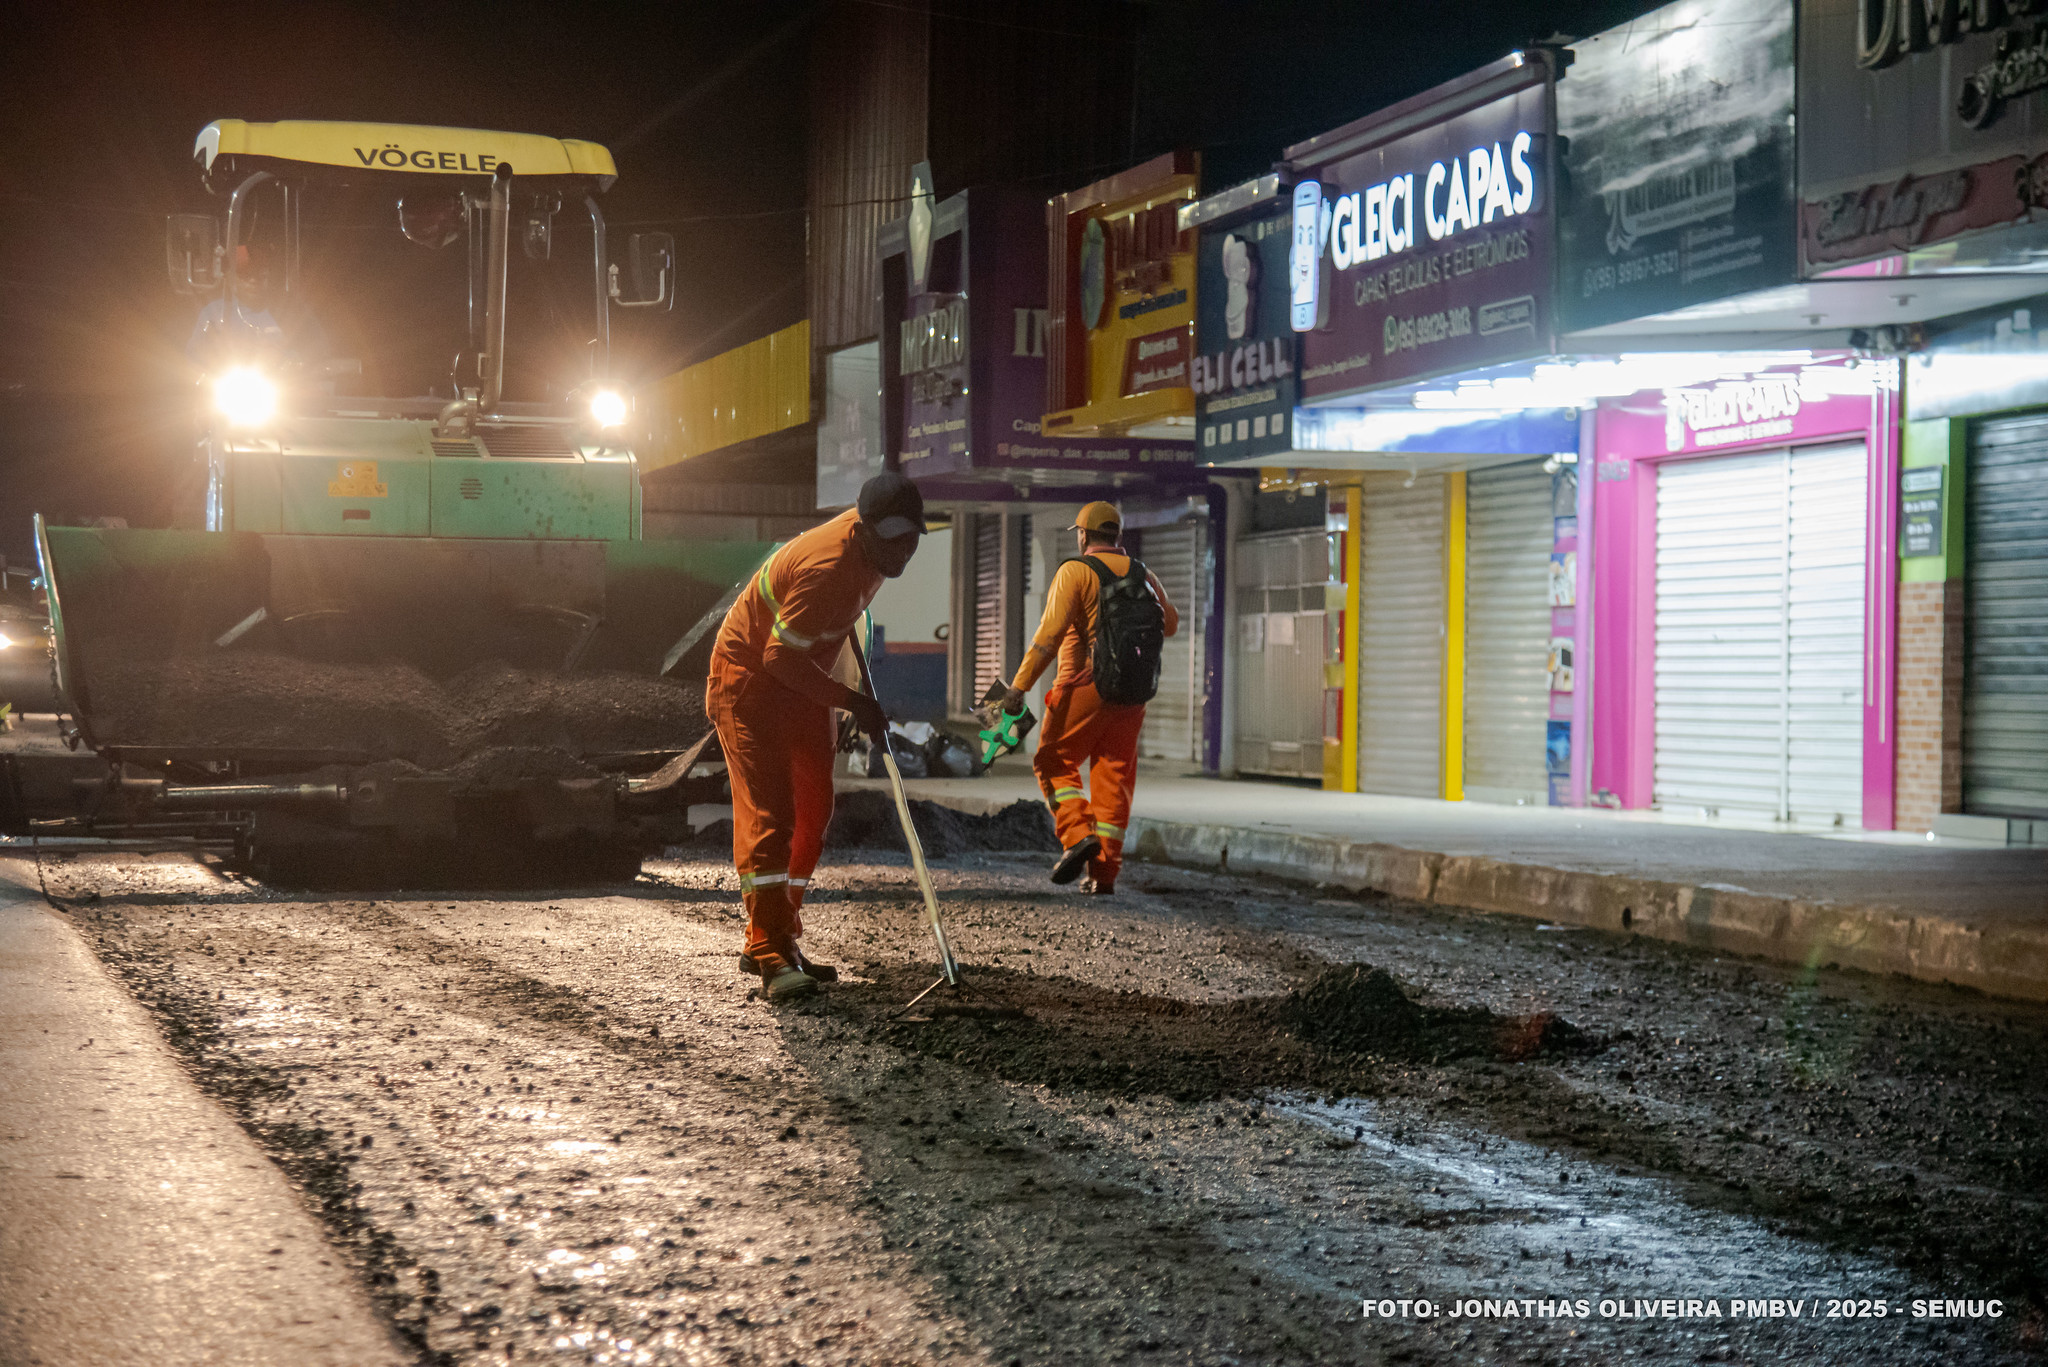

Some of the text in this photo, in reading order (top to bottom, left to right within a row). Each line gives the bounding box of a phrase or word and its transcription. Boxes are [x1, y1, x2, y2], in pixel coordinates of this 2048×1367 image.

[353, 144, 497, 173] VÖGELE
[1331, 131, 1534, 270] GLEICI CAPAS
[1445, 253, 1452, 281] E
[1231, 337, 1289, 389] CELL
